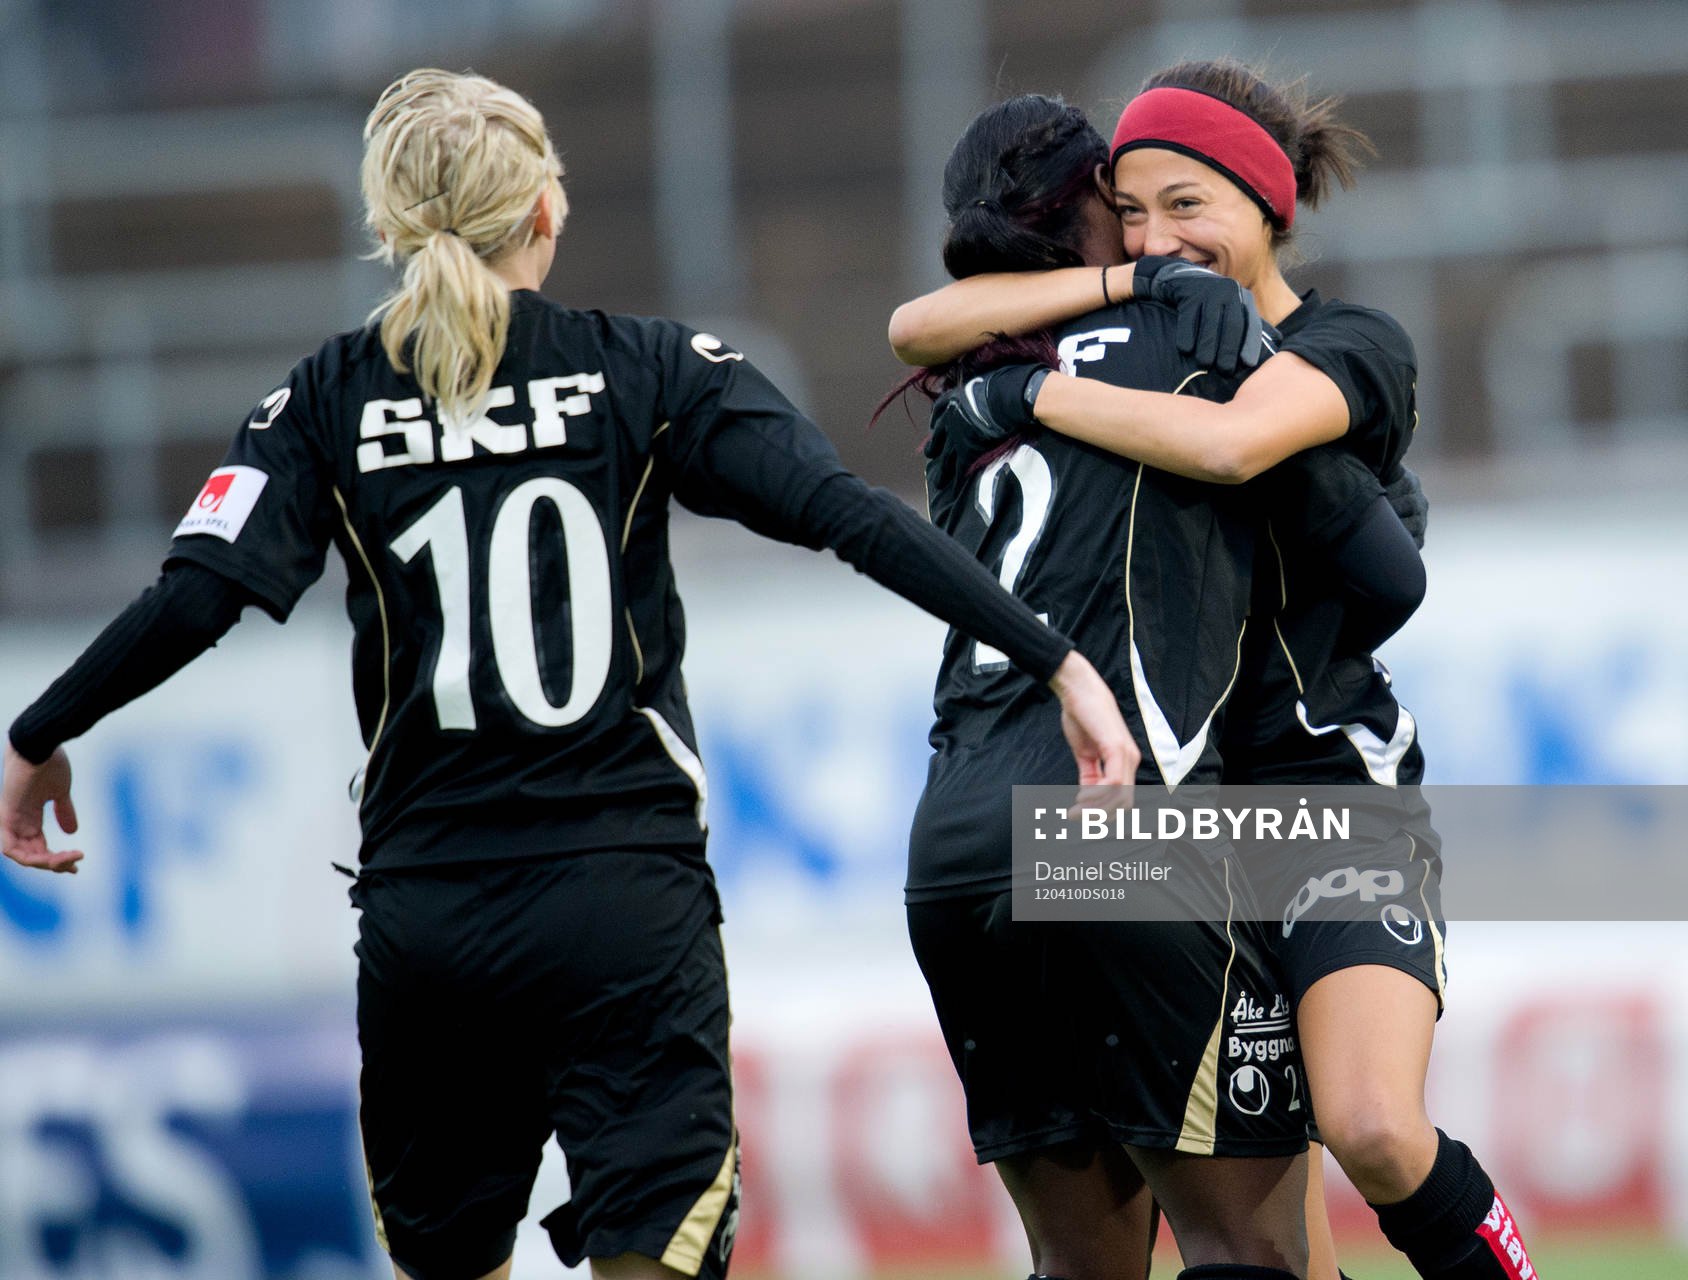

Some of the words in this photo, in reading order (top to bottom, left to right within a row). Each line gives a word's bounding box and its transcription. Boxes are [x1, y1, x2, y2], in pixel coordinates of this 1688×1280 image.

[357, 372, 604, 474] SKF
[974, 444, 1053, 668] 2
[389, 477, 613, 731] 10
[1230, 990, 1264, 1023] Åke
[1284, 1064, 1301, 1112] 2
[1482, 1196, 1538, 1280] Stav
